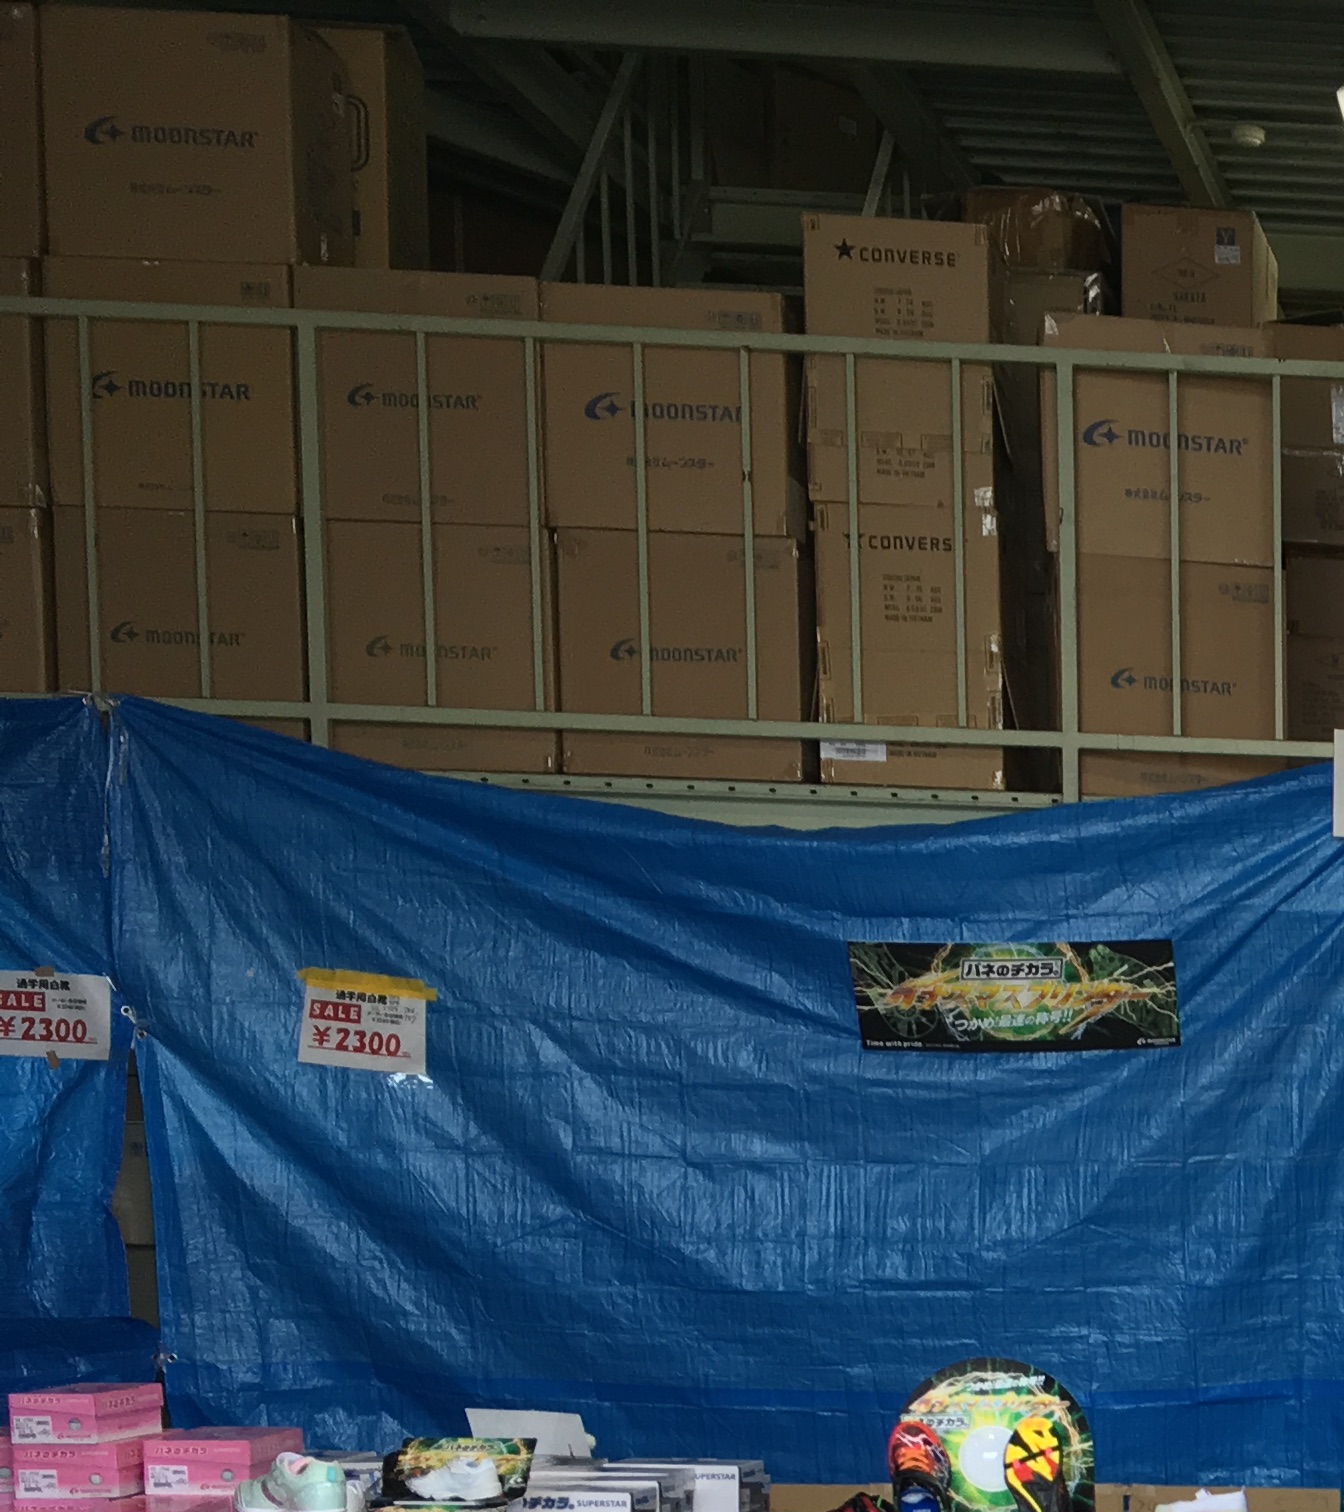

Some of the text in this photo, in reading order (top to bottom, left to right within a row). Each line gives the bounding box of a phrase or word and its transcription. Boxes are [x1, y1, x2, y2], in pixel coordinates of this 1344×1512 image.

[131, 125, 256, 148] MOONSTAR
[860, 246, 957, 268] CONVERSE
[128, 379, 250, 402] MOONTAR
[868, 533, 954, 553] CONVERS
[146, 629, 241, 647] MOONTAR
[312, 1002, 359, 1021] SALE
[0, 1016, 87, 1043] ¥2300
[312, 1024, 401, 1057] ¥2300
